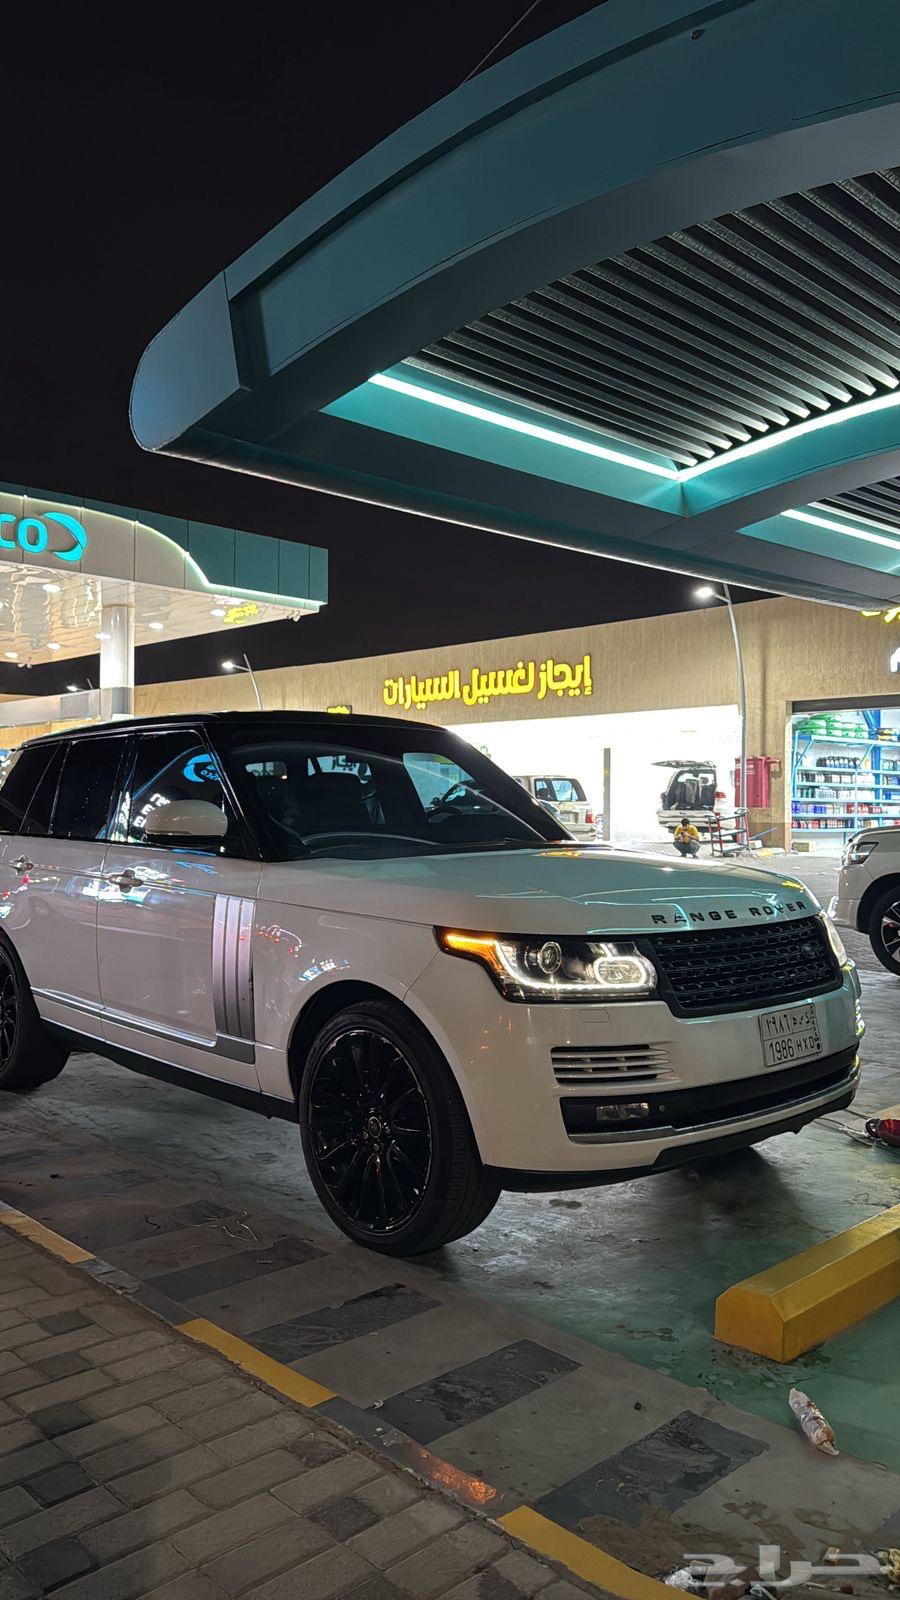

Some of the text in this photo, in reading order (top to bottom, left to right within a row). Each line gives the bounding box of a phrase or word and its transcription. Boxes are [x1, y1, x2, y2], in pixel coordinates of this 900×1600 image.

[383, 655, 592, 710] إيجاز لغسيل السيارات
[651, 901, 807, 925] RANGE ROVER
[769, 1038, 795, 1062] 1986
